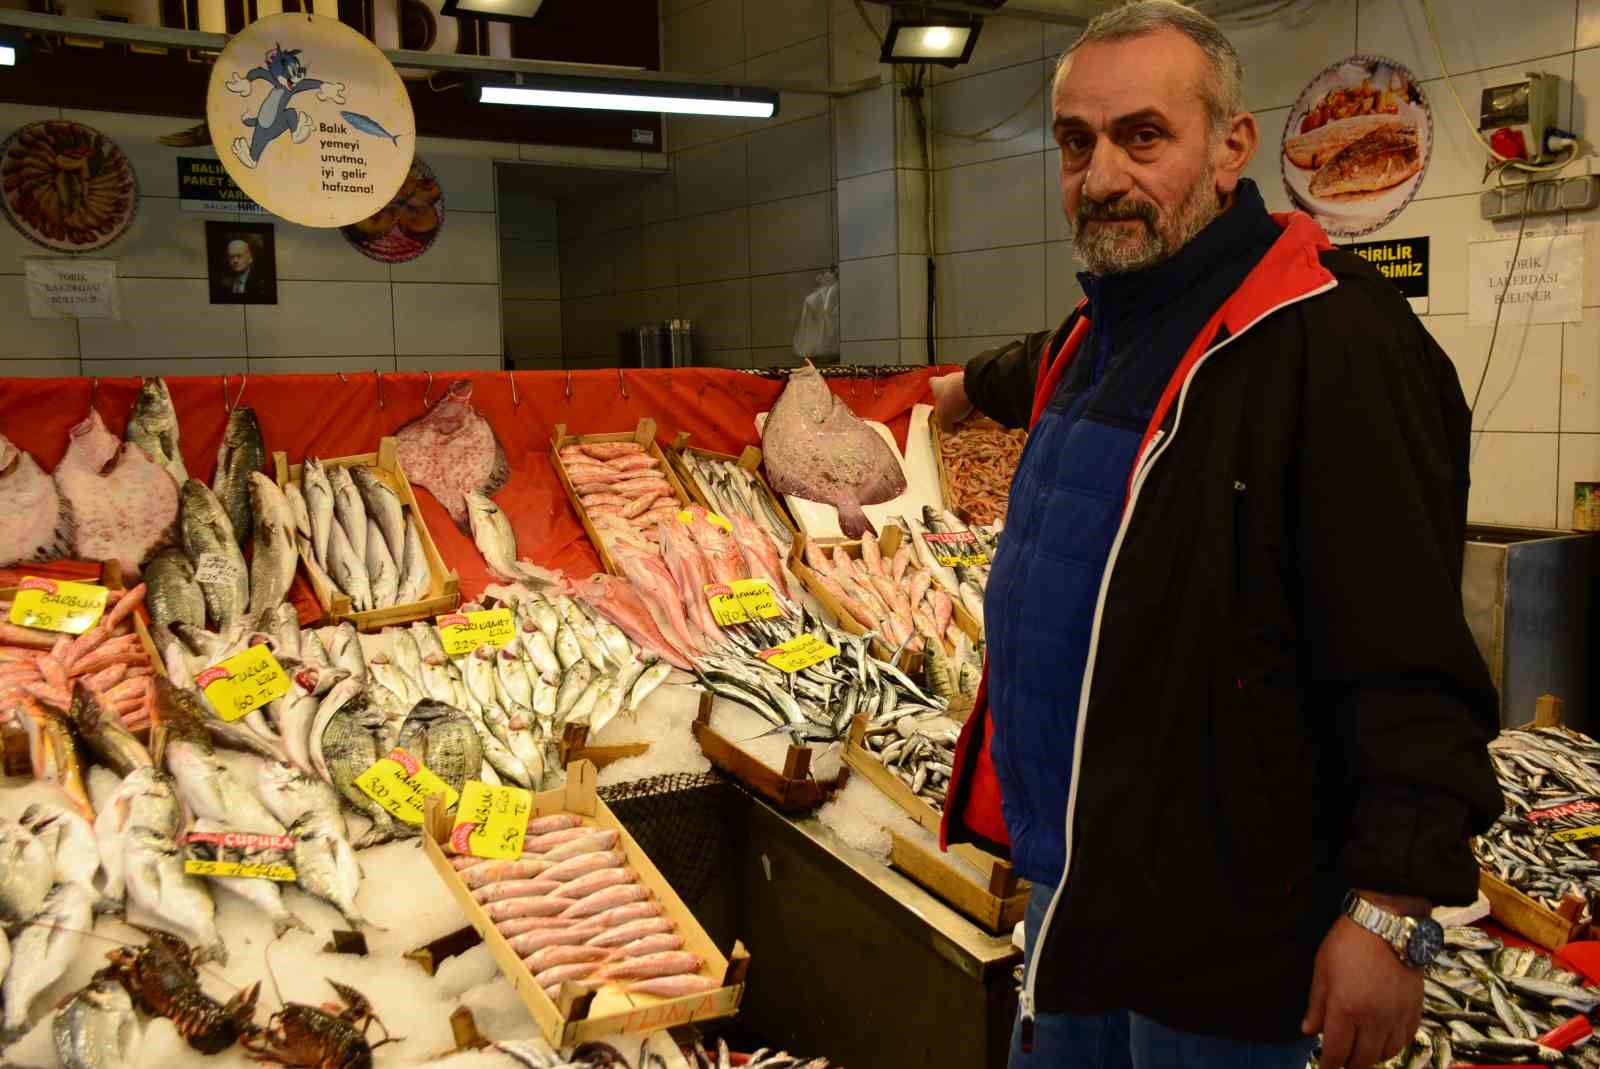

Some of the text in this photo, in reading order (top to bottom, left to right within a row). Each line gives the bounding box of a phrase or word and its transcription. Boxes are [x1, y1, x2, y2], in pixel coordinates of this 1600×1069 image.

[319, 122, 348, 135] Balık
[320, 139, 360, 152] yemeyi
[321, 154, 368, 166] unutma,
[321, 166, 368, 181] iyi gelir
[183, 175, 224, 186] PAKET
[322, 180, 375, 194] hafızana!
